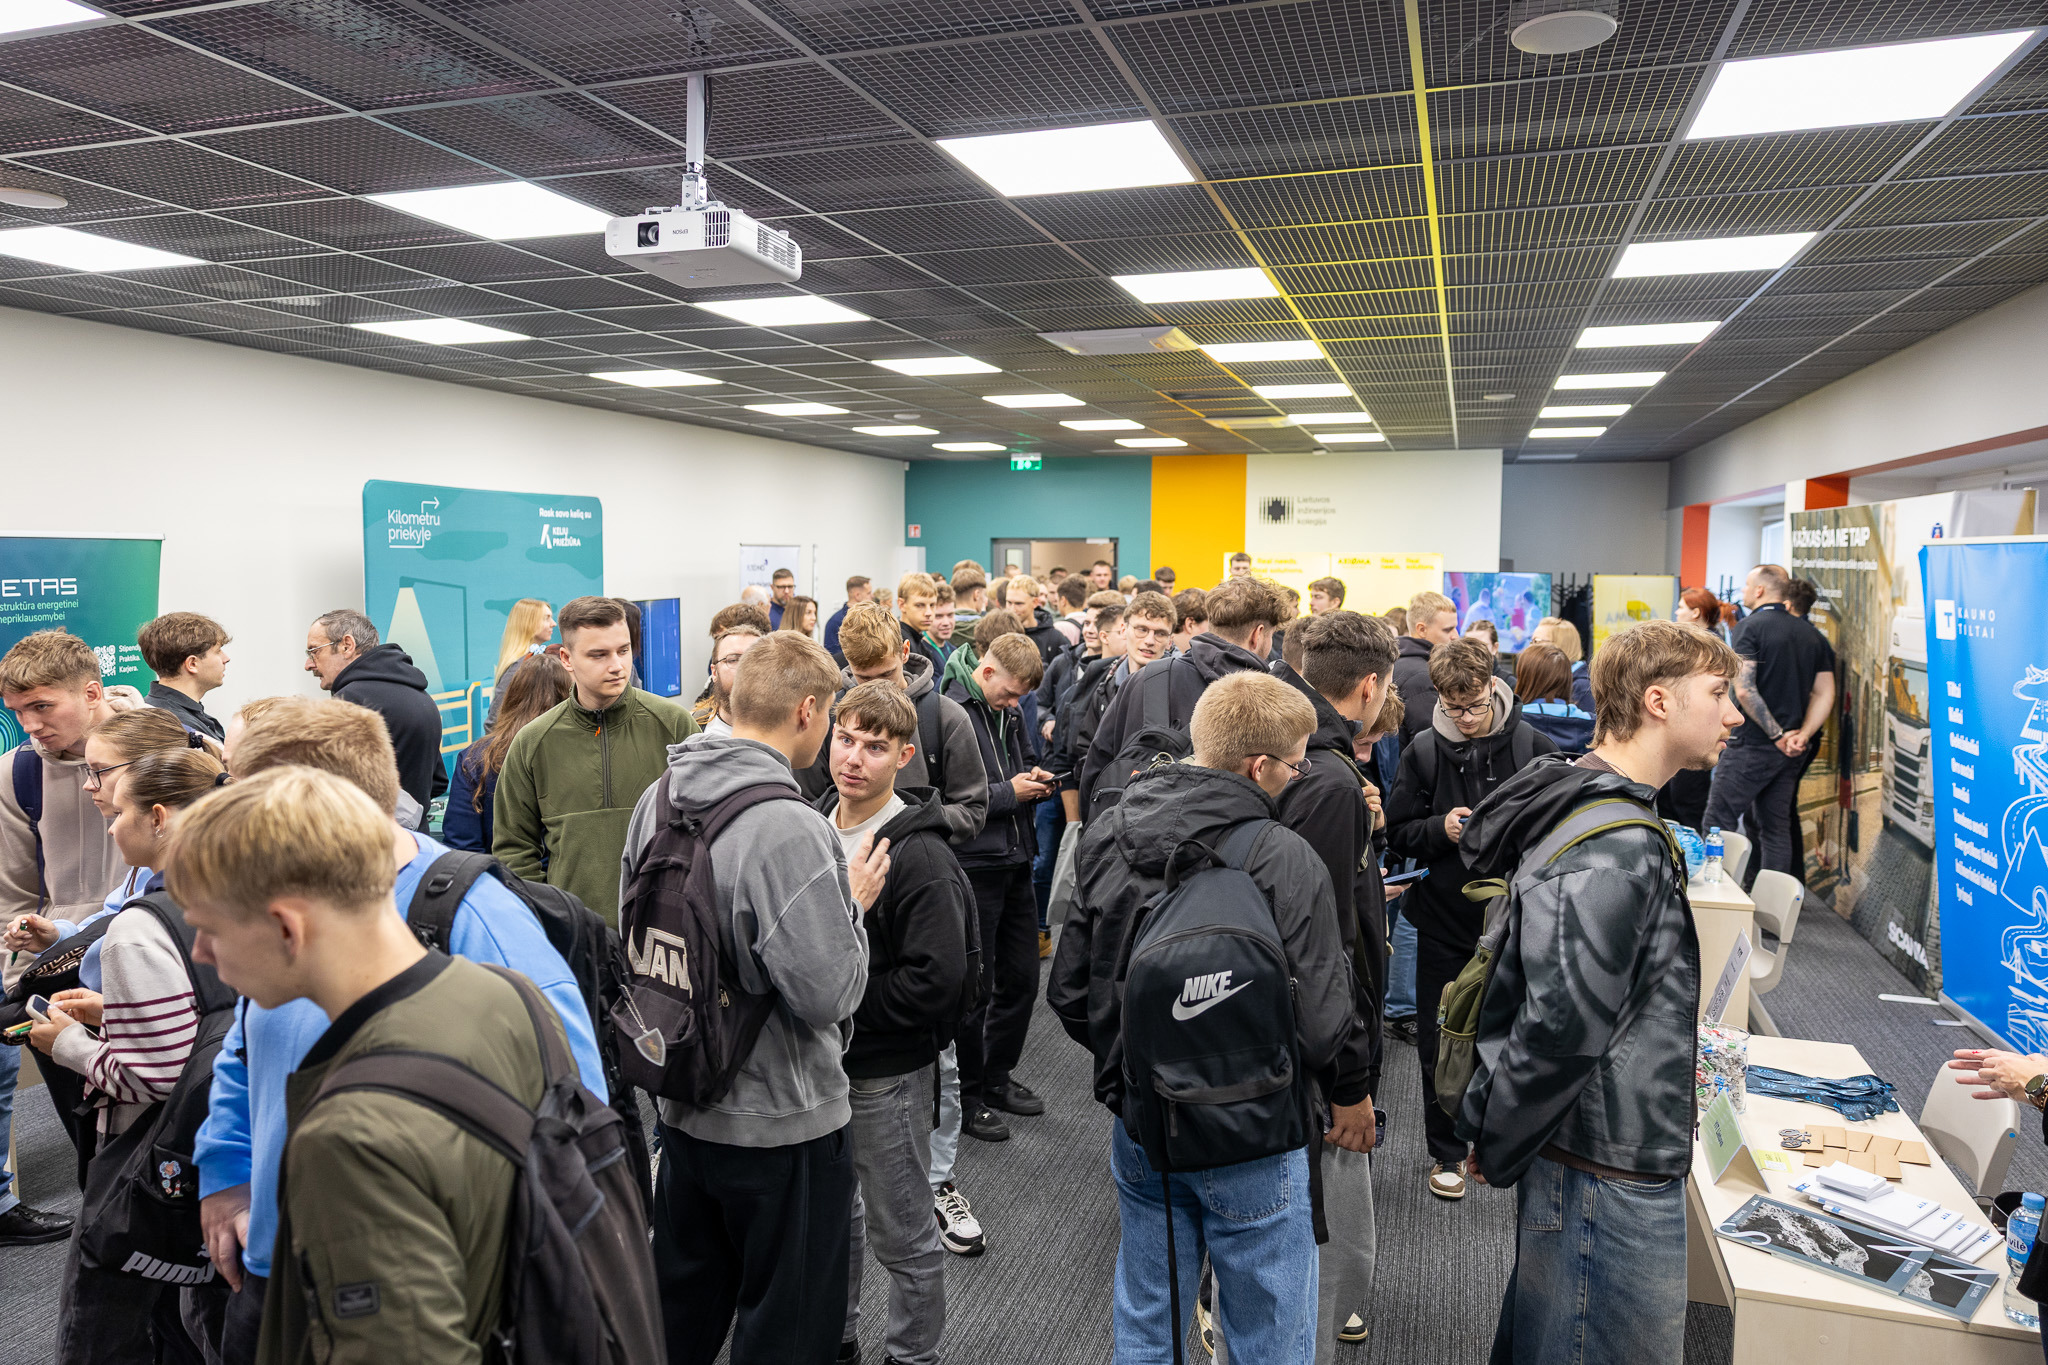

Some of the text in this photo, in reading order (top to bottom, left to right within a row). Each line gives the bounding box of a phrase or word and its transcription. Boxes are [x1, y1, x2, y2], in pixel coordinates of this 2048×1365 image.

[387, 509, 440, 526] Kilometru
[36, 599, 79, 611] energetinei
[1957, 607, 1996, 622] KAUNO
[1957, 623, 1995, 639] TILTAI
[1888, 921, 1929, 971] SCANIA
[628, 926, 693, 999] VAN
[1181, 970, 1232, 1003] NIKE
[120, 1250, 216, 1285] PUMA
